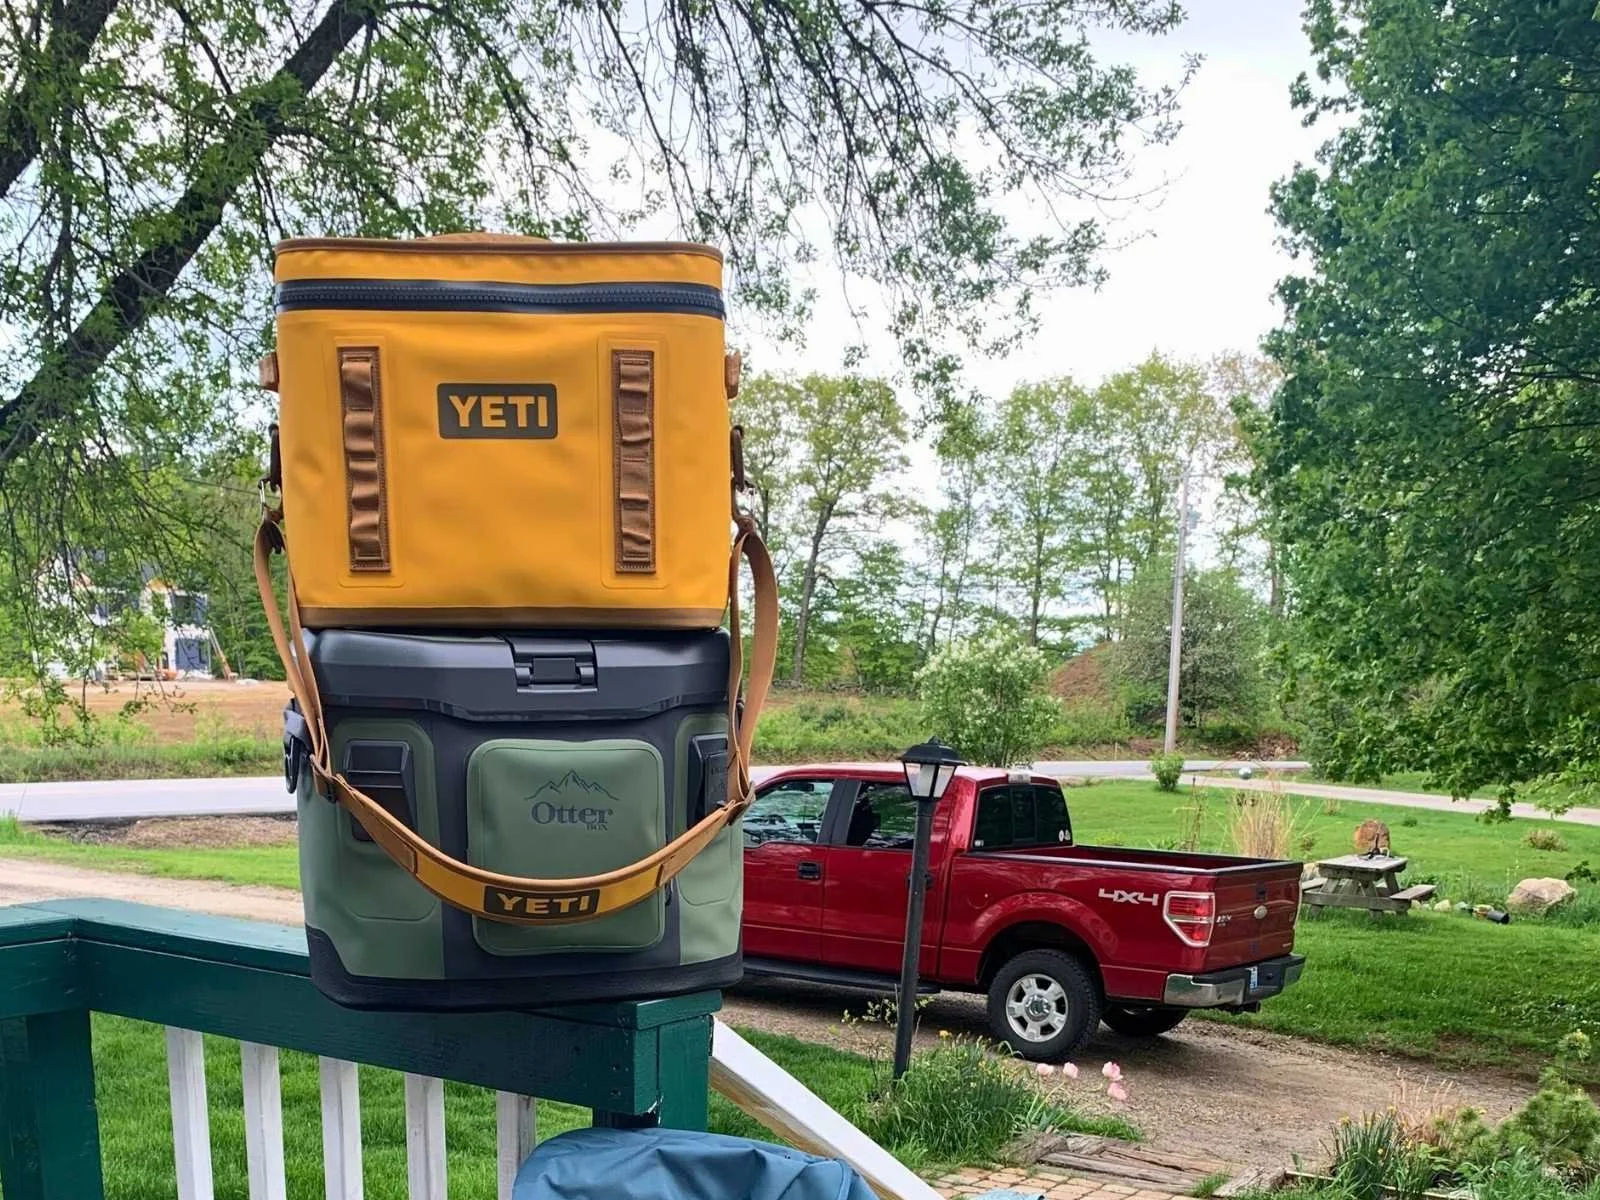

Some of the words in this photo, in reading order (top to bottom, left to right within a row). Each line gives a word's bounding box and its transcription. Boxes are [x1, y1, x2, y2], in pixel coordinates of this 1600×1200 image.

[448, 395, 548, 428] YETI
[531, 801, 608, 825] Otter
[497, 893, 590, 914] YETI
